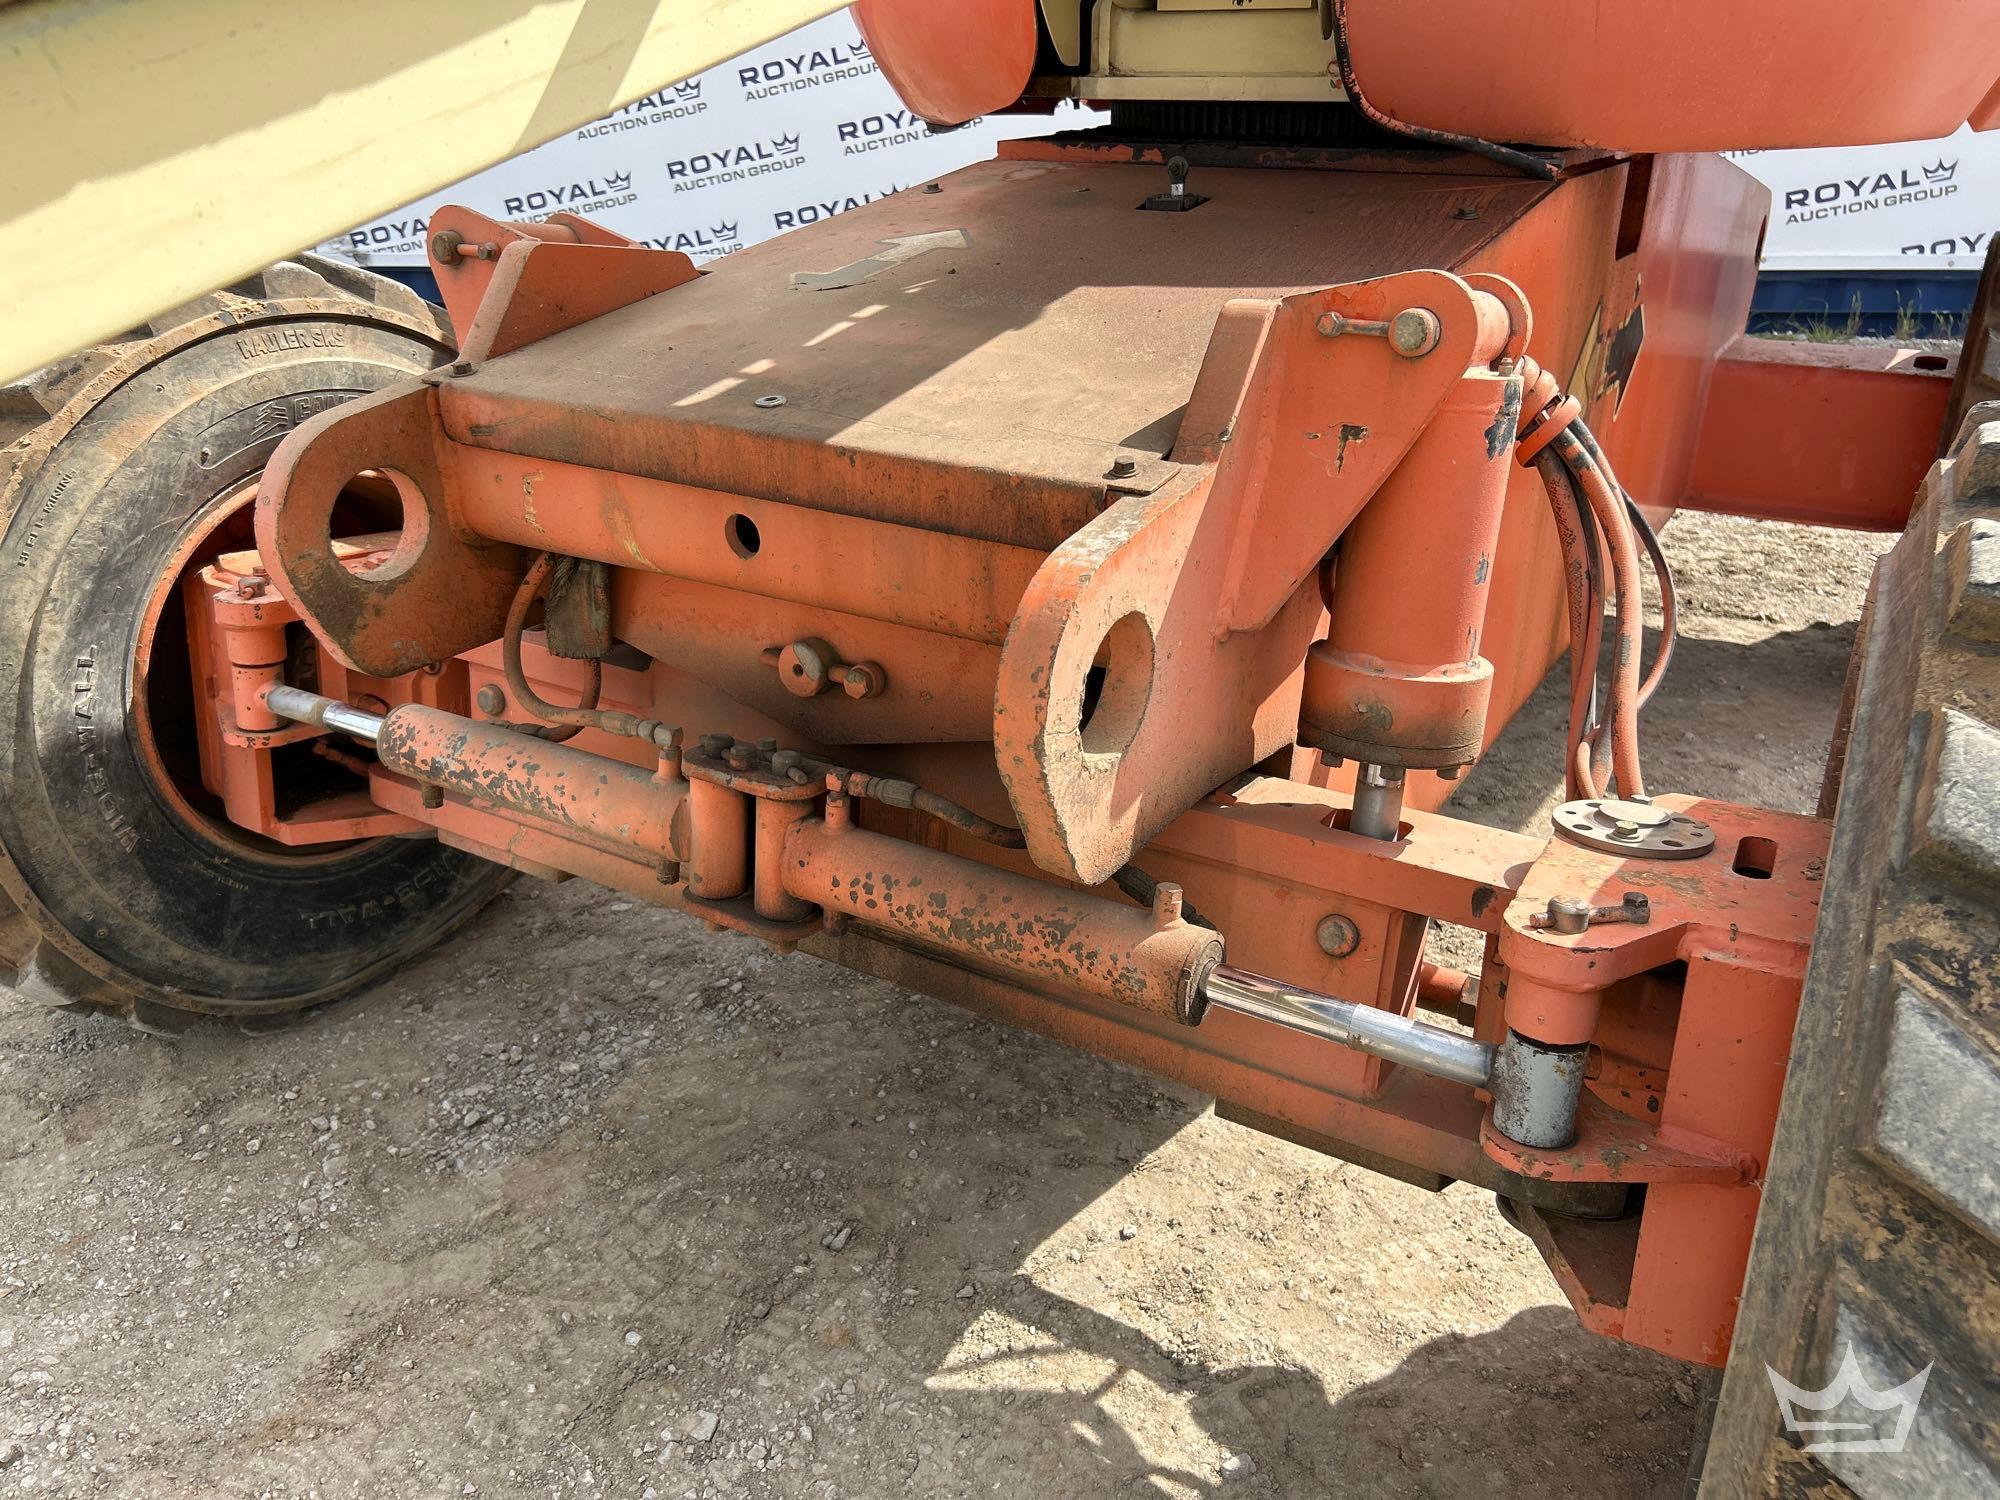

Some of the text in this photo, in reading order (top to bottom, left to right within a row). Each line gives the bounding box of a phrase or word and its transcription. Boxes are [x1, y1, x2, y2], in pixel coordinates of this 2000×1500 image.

[738, 47, 850, 88] ROYAL
[745, 76, 820, 102] AUCTION
[577, 116, 649, 141] AUCTION
[651, 102, 708, 124] GROUP
[667, 143, 773, 180] ROYAL
[844, 130, 920, 157] AUCTION
[673, 156, 807, 194] AUCTION GROUP
[1785, 169, 1921, 210] ROYAL
[504, 180, 607, 216] ROYAL
[583, 193, 638, 213] GROUP
[1786, 184, 1959, 225] AUCTION GROUP
[350, 218, 428, 248] ROYA
[236, 328, 345, 360] HAULER SKS
